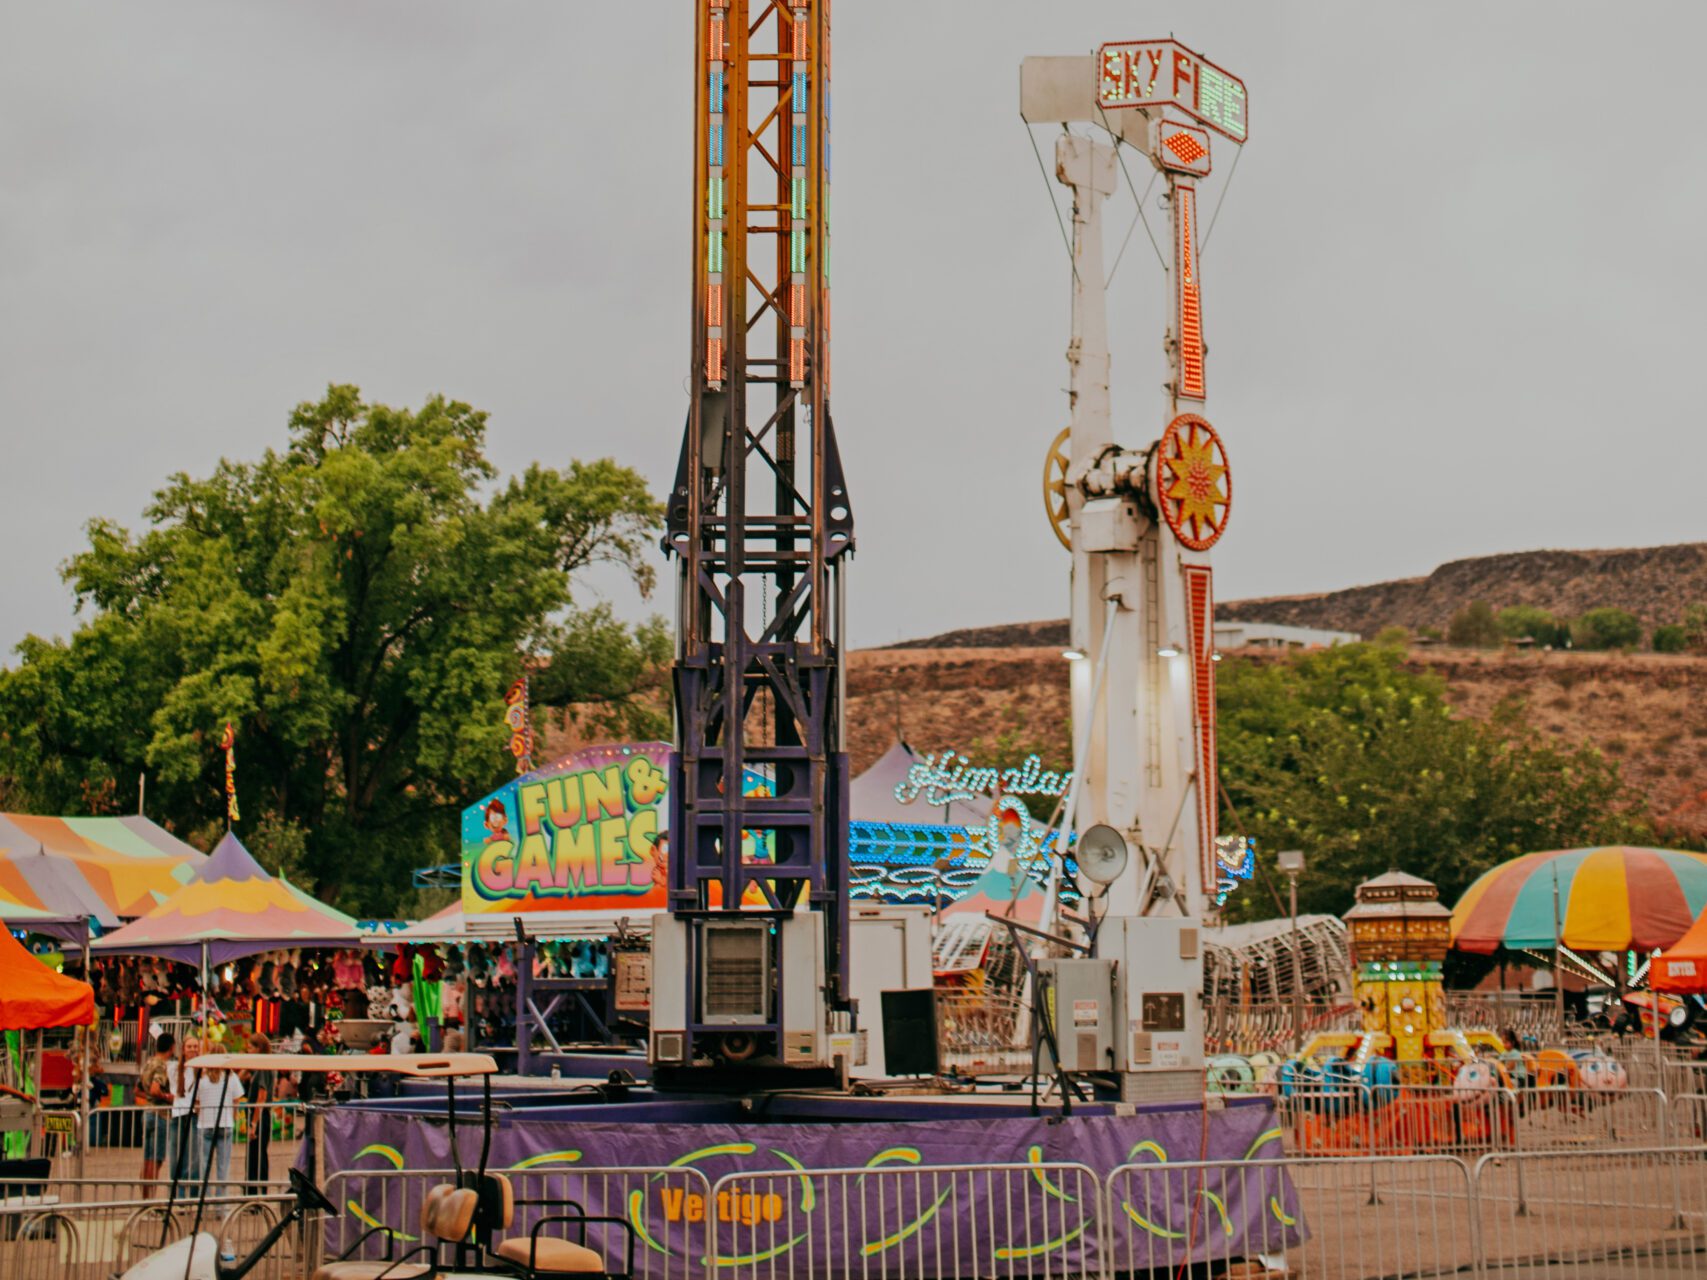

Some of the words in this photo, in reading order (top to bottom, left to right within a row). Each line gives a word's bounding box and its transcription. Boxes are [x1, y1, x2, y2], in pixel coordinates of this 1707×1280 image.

[1103, 48, 1162, 100] SKY
[1172, 50, 1246, 137] FIRE
[518, 765, 626, 837] FUN
[626, 756, 669, 807] &
[474, 808, 660, 894] GAMES
